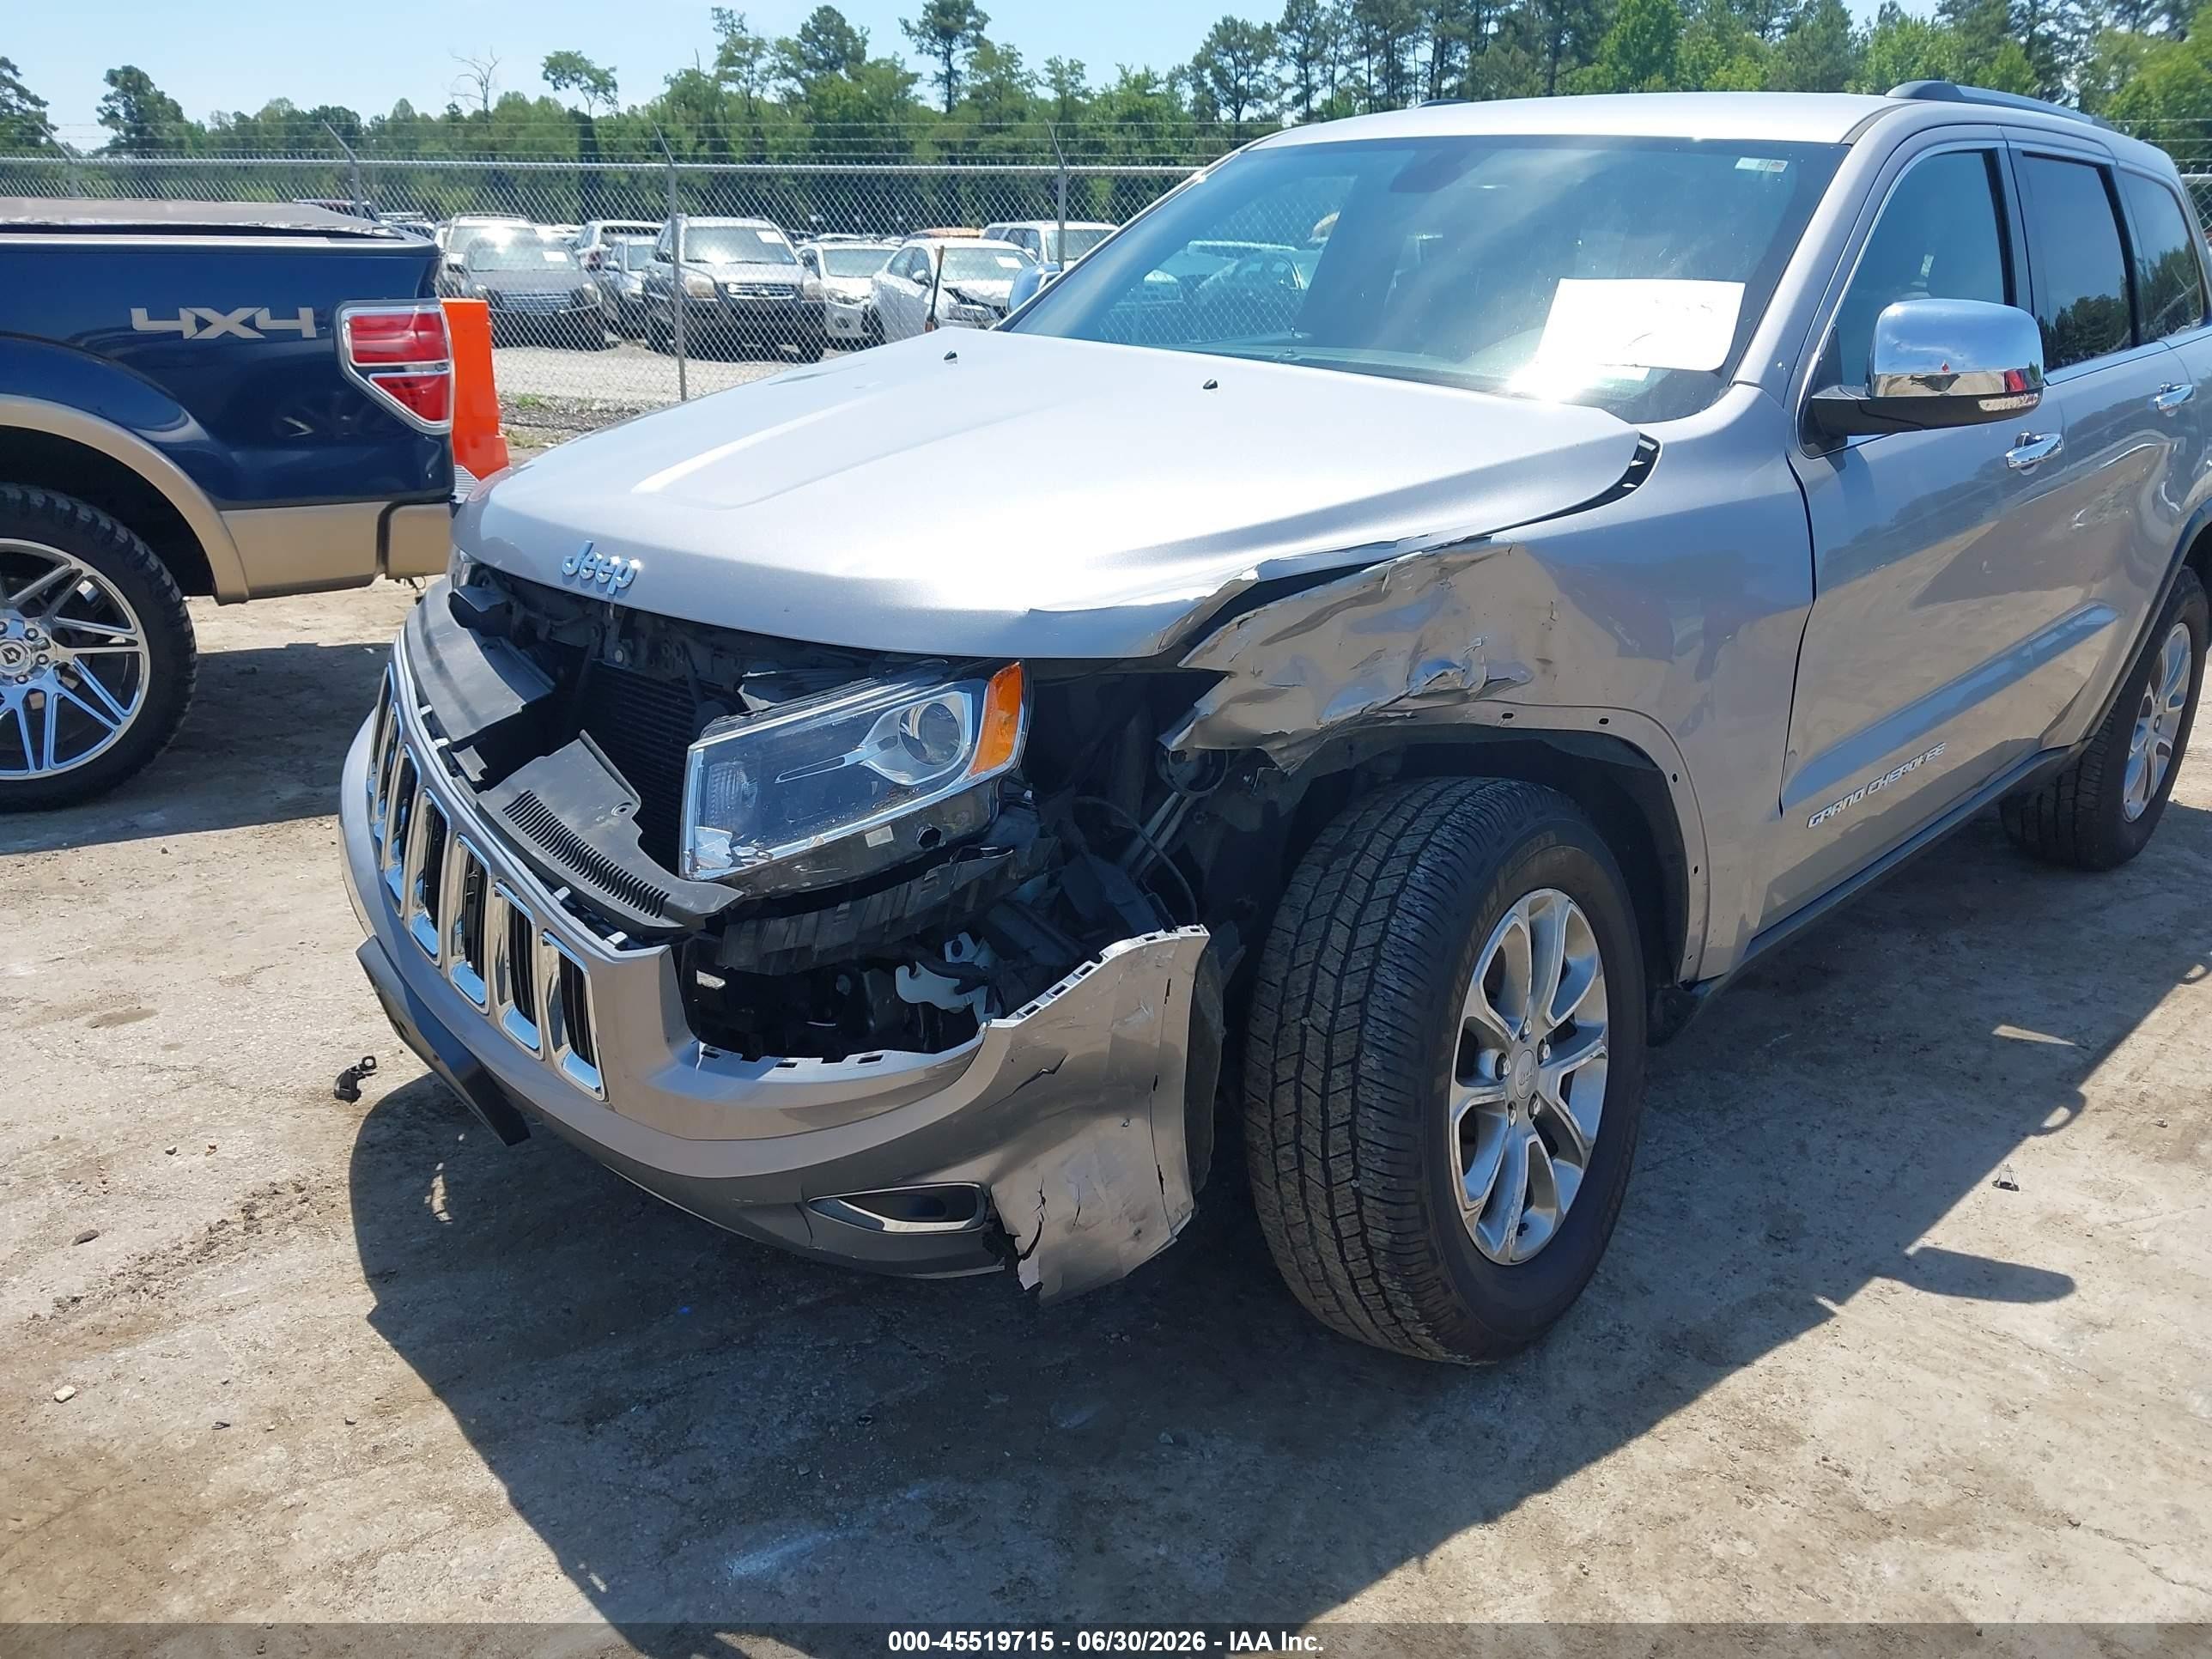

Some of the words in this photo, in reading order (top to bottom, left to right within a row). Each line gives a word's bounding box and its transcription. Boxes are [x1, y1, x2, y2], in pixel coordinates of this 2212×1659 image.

[131, 307, 317, 339] 4X4
[562, 539, 641, 595] Jeep
[1807, 787, 1865, 829] GRAND
[1866, 742, 1947, 795] CHEROKEE
